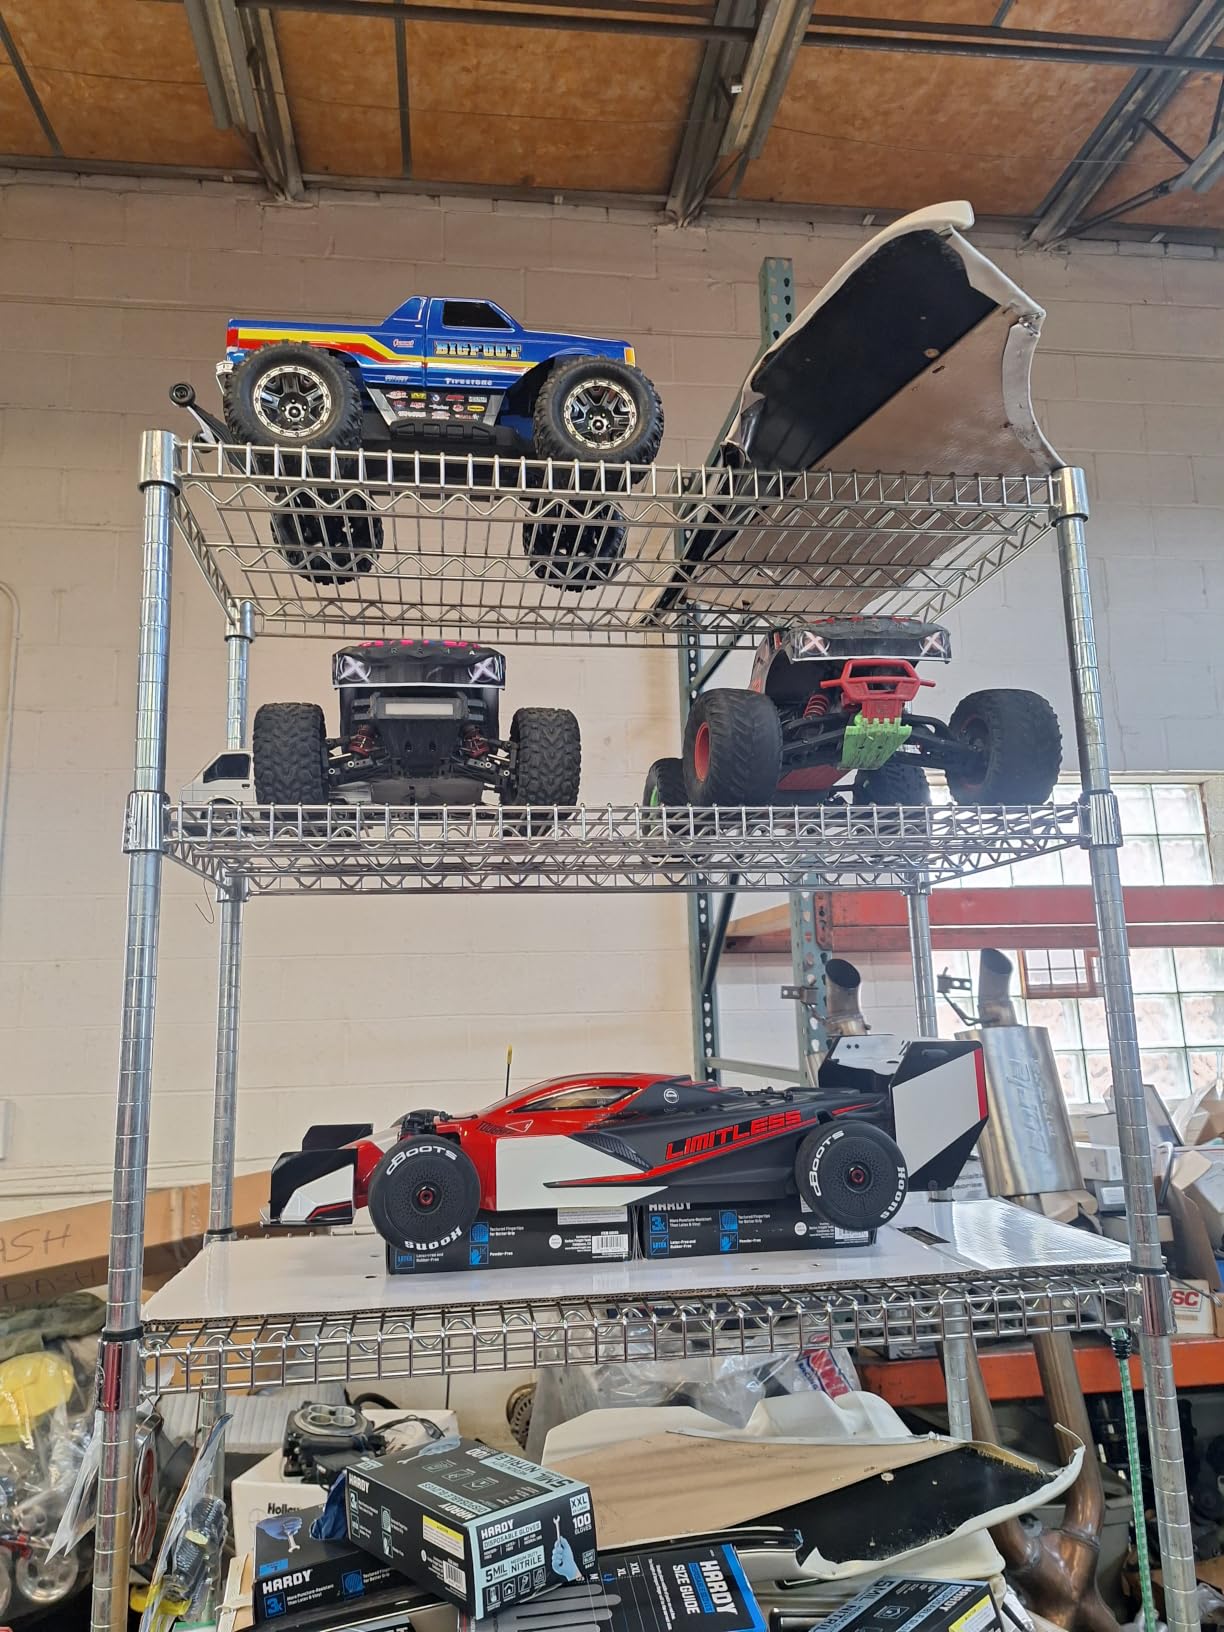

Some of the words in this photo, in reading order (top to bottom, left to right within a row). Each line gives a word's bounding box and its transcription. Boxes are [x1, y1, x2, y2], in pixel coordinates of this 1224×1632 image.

[435, 340, 521, 358] BIGFOOT
[665, 1110, 801, 1160] LIMITLESS
[495, 1454, 540, 1473] NITRILE
[267, 1502, 300, 1515] Holle
[571, 1496, 588, 1508] XXL
[438, 1503, 477, 1520] HARDY
[572, 1512, 592, 1529] 100
[481, 1519, 515, 1540] HARDY
[574, 1524, 593, 1536] GLOVES
[483, 1531, 518, 1549] DISPOSABLE
[511, 1555, 543, 1573] NITRILE
[616, 1567, 627, 1577] XL
[629, 1562, 641, 1575] XXL
[262, 1569, 313, 1595] HARDY
[672, 1564, 689, 1585] SIZE
[699, 1560, 738, 1615] HARDY
[679, 1585, 701, 1615] GUIDE
[939, 1586, 975, 1612] HARDY
[813, 1604, 857, 1632] NITRIL
